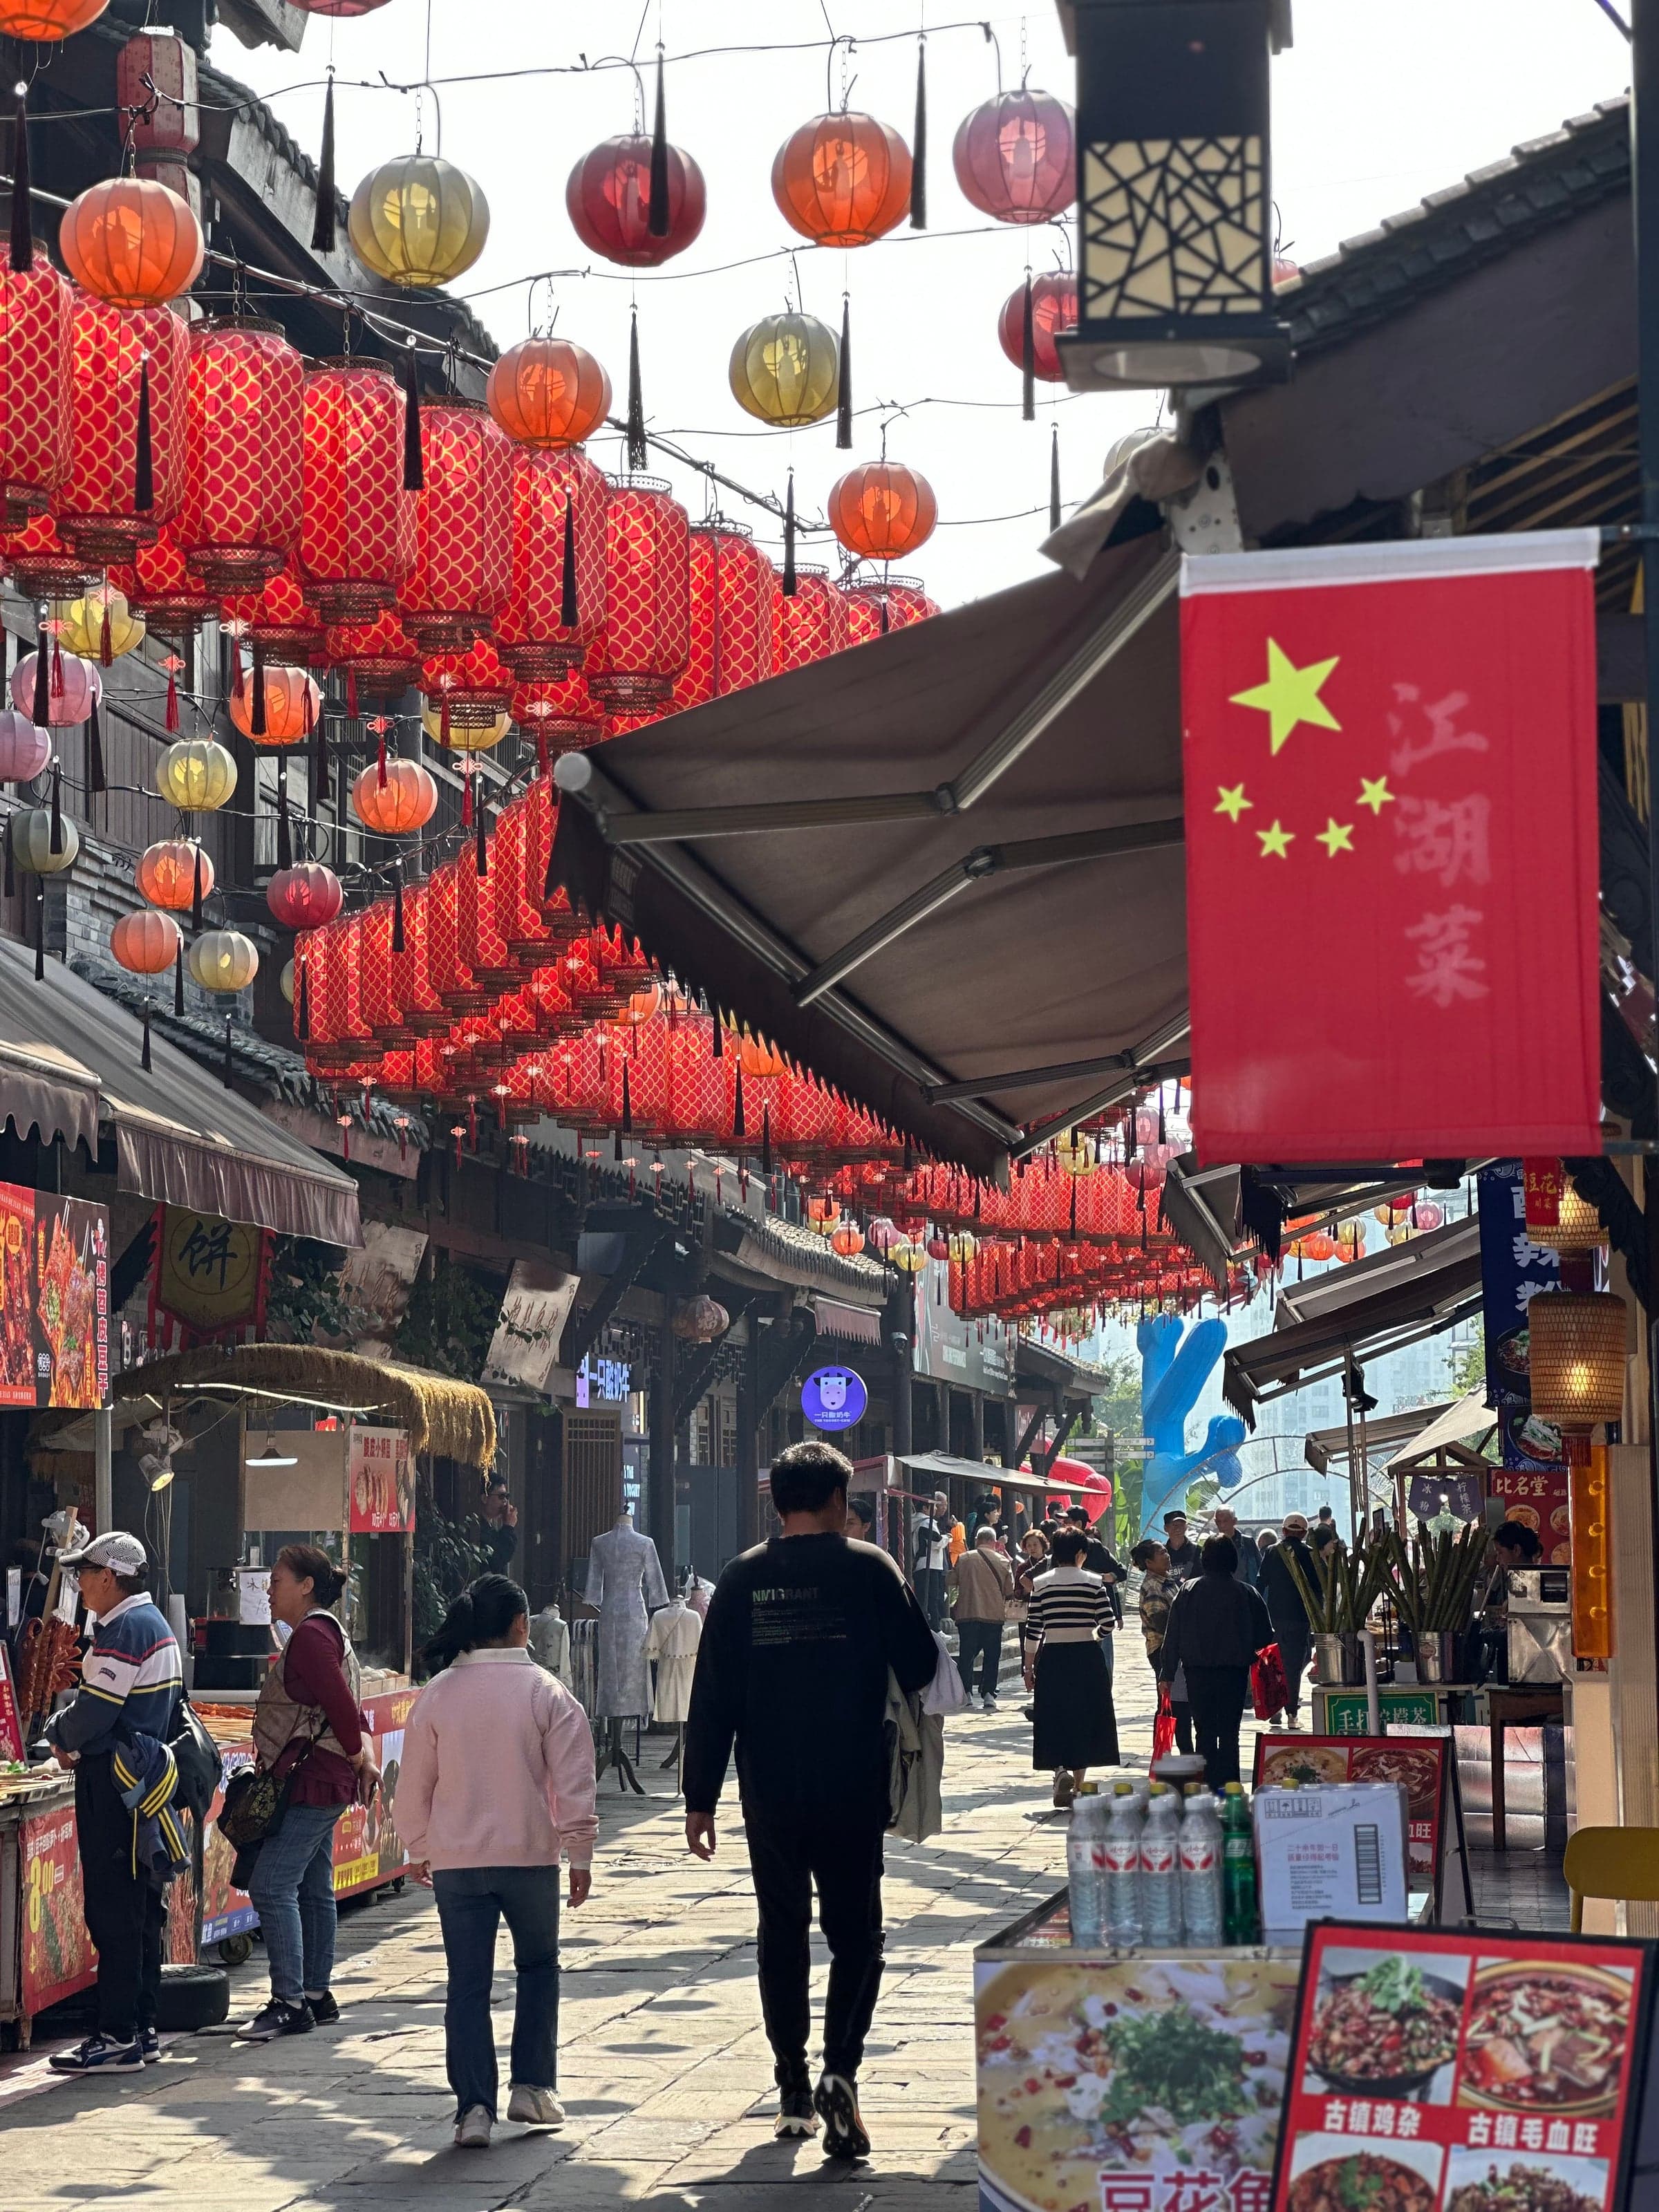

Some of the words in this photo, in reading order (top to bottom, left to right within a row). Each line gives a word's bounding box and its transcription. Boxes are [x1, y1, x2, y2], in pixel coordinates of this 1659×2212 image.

[1387, 682, 1492, 1009] 江湖菜
[178, 1219, 238, 1291] 饼
[589, 1359, 630, 1403] 一只酸奶牛
[1419, 1483, 1433, 1512] 冰粉
[1456, 1481, 1472, 1515] 柠檬茶
[1496, 1475, 1549, 1497] 比名堂
[1323, 2099, 1423, 2137] 古镇鸡杂
[1468, 2112, 1600, 2154] 古镇毛血旺
